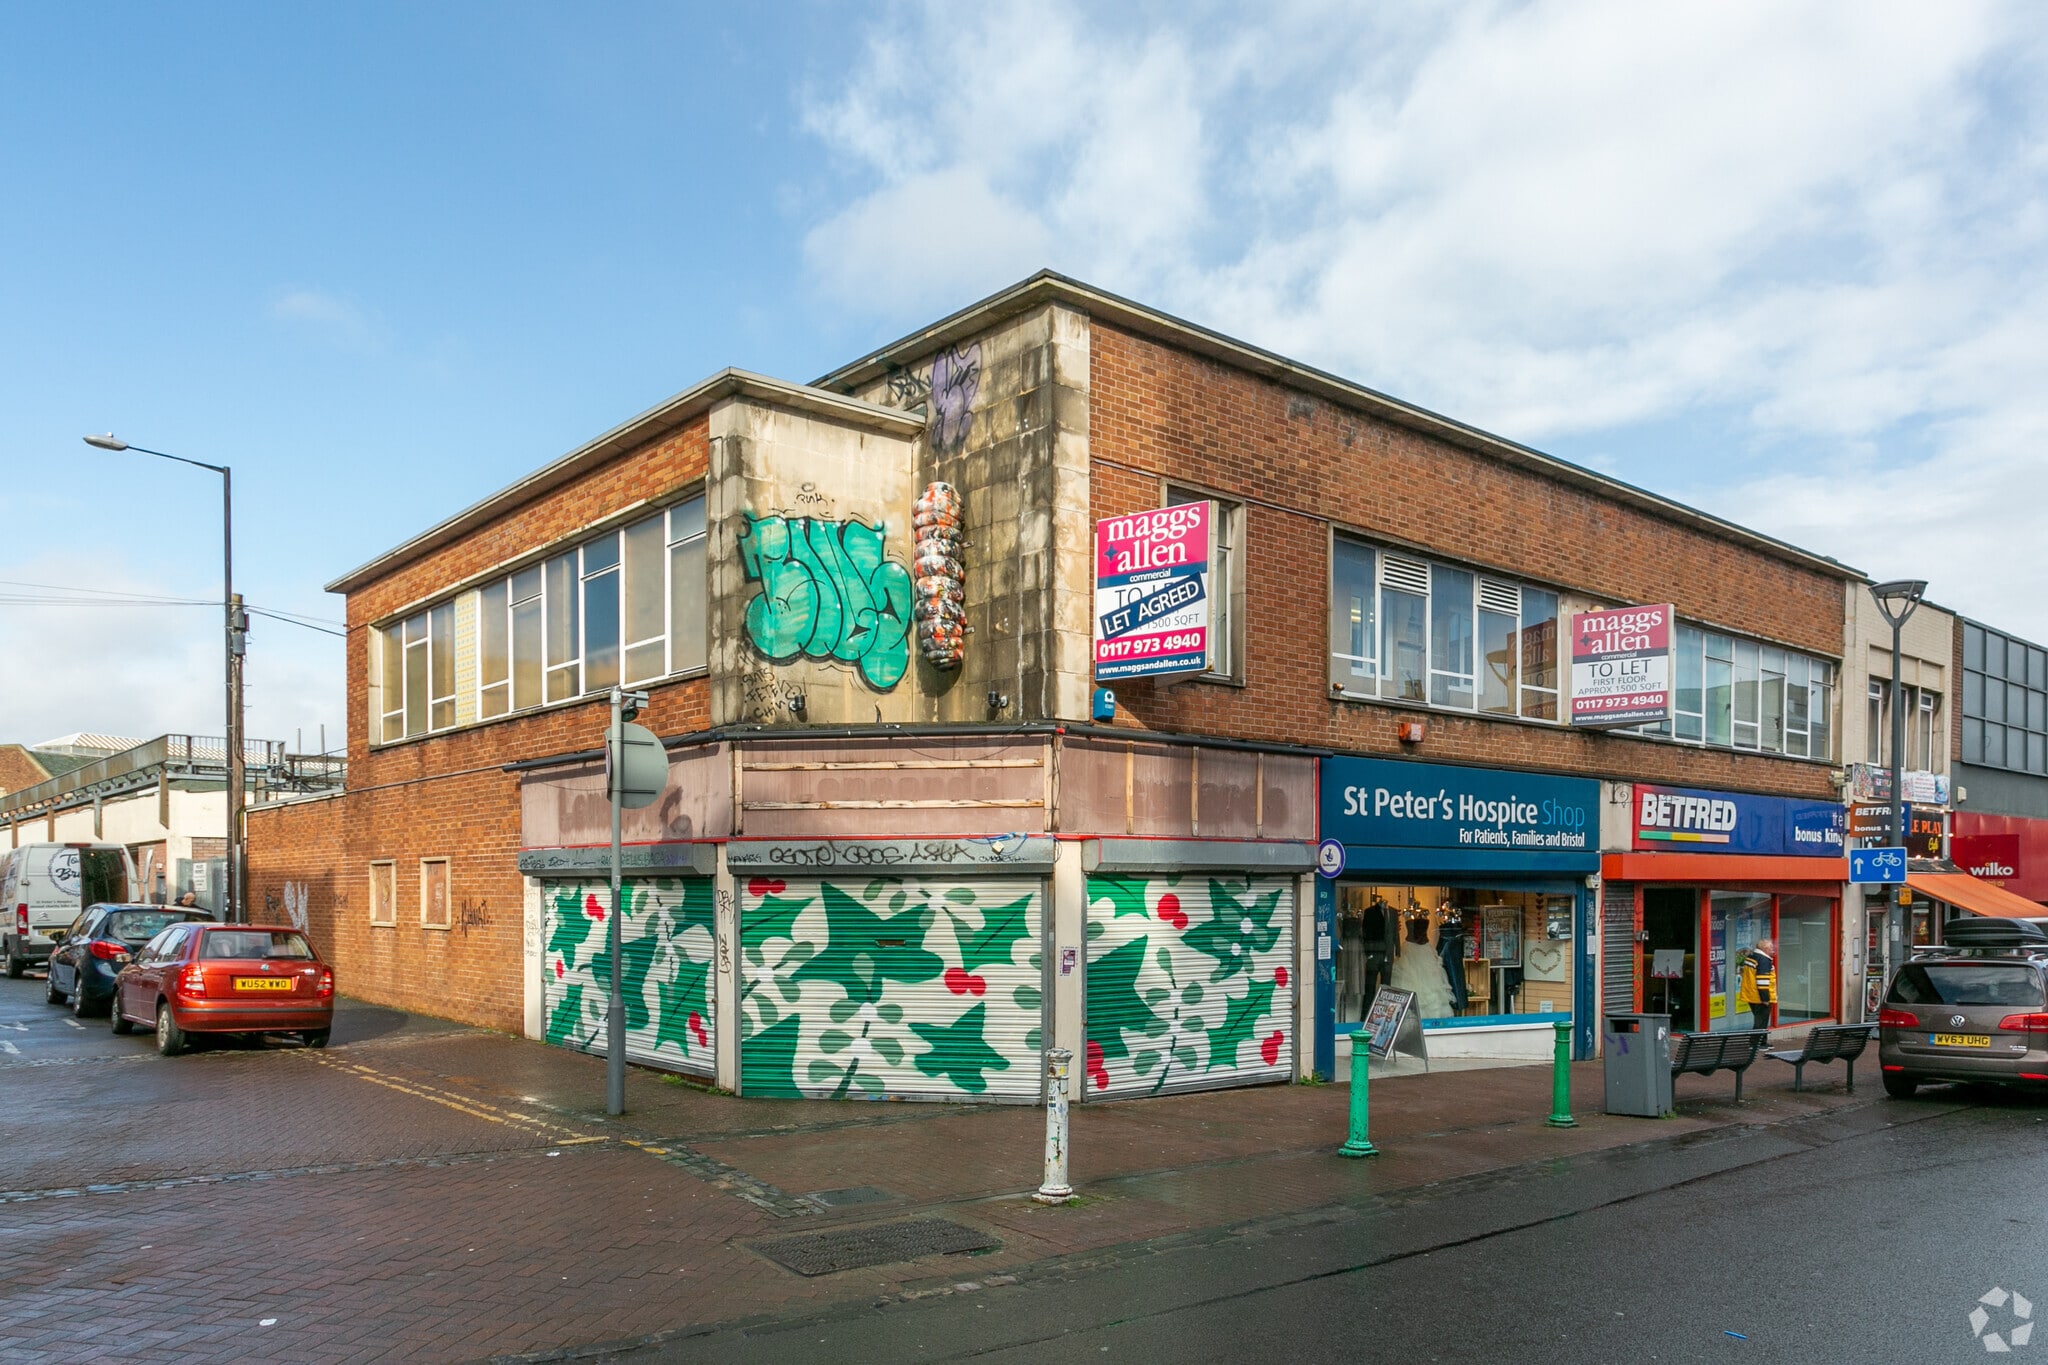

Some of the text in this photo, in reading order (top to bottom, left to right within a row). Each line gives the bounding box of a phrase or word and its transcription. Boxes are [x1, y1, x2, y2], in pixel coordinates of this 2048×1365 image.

[1107, 506, 1200, 543] maggs
[1117, 539, 1187, 572] allen
[1129, 568, 1171, 583] commercial
[1115, 587, 1143, 609] TO
[1105, 580, 1200, 636] LET AGREED
[1174, 613, 1200, 626] SQFT
[1582, 610, 1662, 635] maggs
[1099, 632, 1200, 658] 0117 973 4940
[1591, 632, 1651, 654] allen
[1098, 655, 1201, 675] www.maggsandallen.co.uk
[1601, 651, 1637, 661] commercial
[1588, 659, 1651, 678] TO LET
[1578, 682, 1662, 696] APPROX 1500 SQFT
[1593, 675, 1647, 686] FIRST FLOOR
[1576, 694, 1663, 710] 0117 973 4940
[1575, 710, 1664, 721] www.maggsandallen.co.uk
[1343, 786, 1585, 832] St Peter's Hospice Shop
[1640, 792, 1737, 832] BETFRED
[1795, 826, 1843, 846] bonus king
[1921, 820, 1943, 834] PLAY
[1459, 828, 1585, 847] For Patients, Families and Bristol
[1969, 862, 2014, 876] wilko
[1936, 1034, 1989, 1046] WV63 UHG
